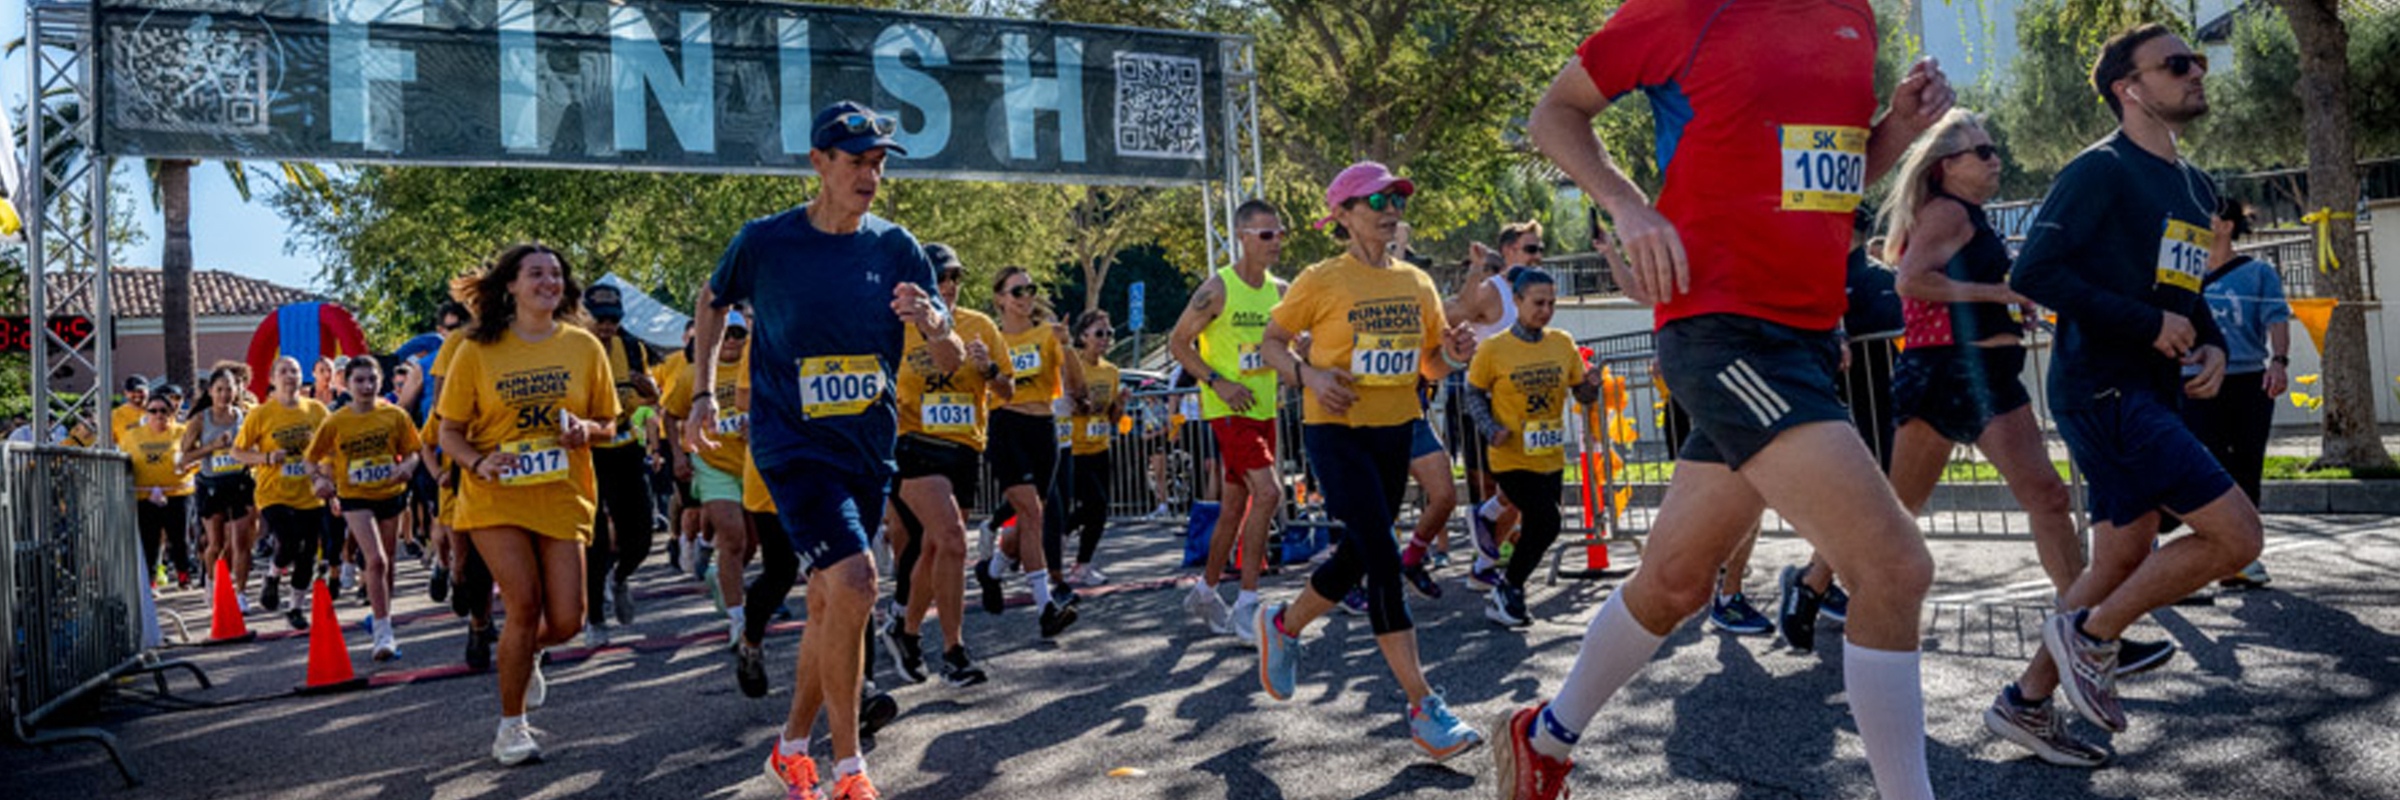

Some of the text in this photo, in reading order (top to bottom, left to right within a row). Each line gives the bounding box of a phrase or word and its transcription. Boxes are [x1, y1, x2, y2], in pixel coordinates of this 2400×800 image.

[328, 0, 1087, 163] FINISH
[1813, 131, 1837, 149] 5K
[1796, 151, 1862, 193] 1080
[1361, 351, 1414, 375] 1001
[810, 374, 878, 402] 1006
[925, 371, 957, 393] 5K
[517, 404, 552, 429] 5K
[928, 405, 971, 424] 1031
